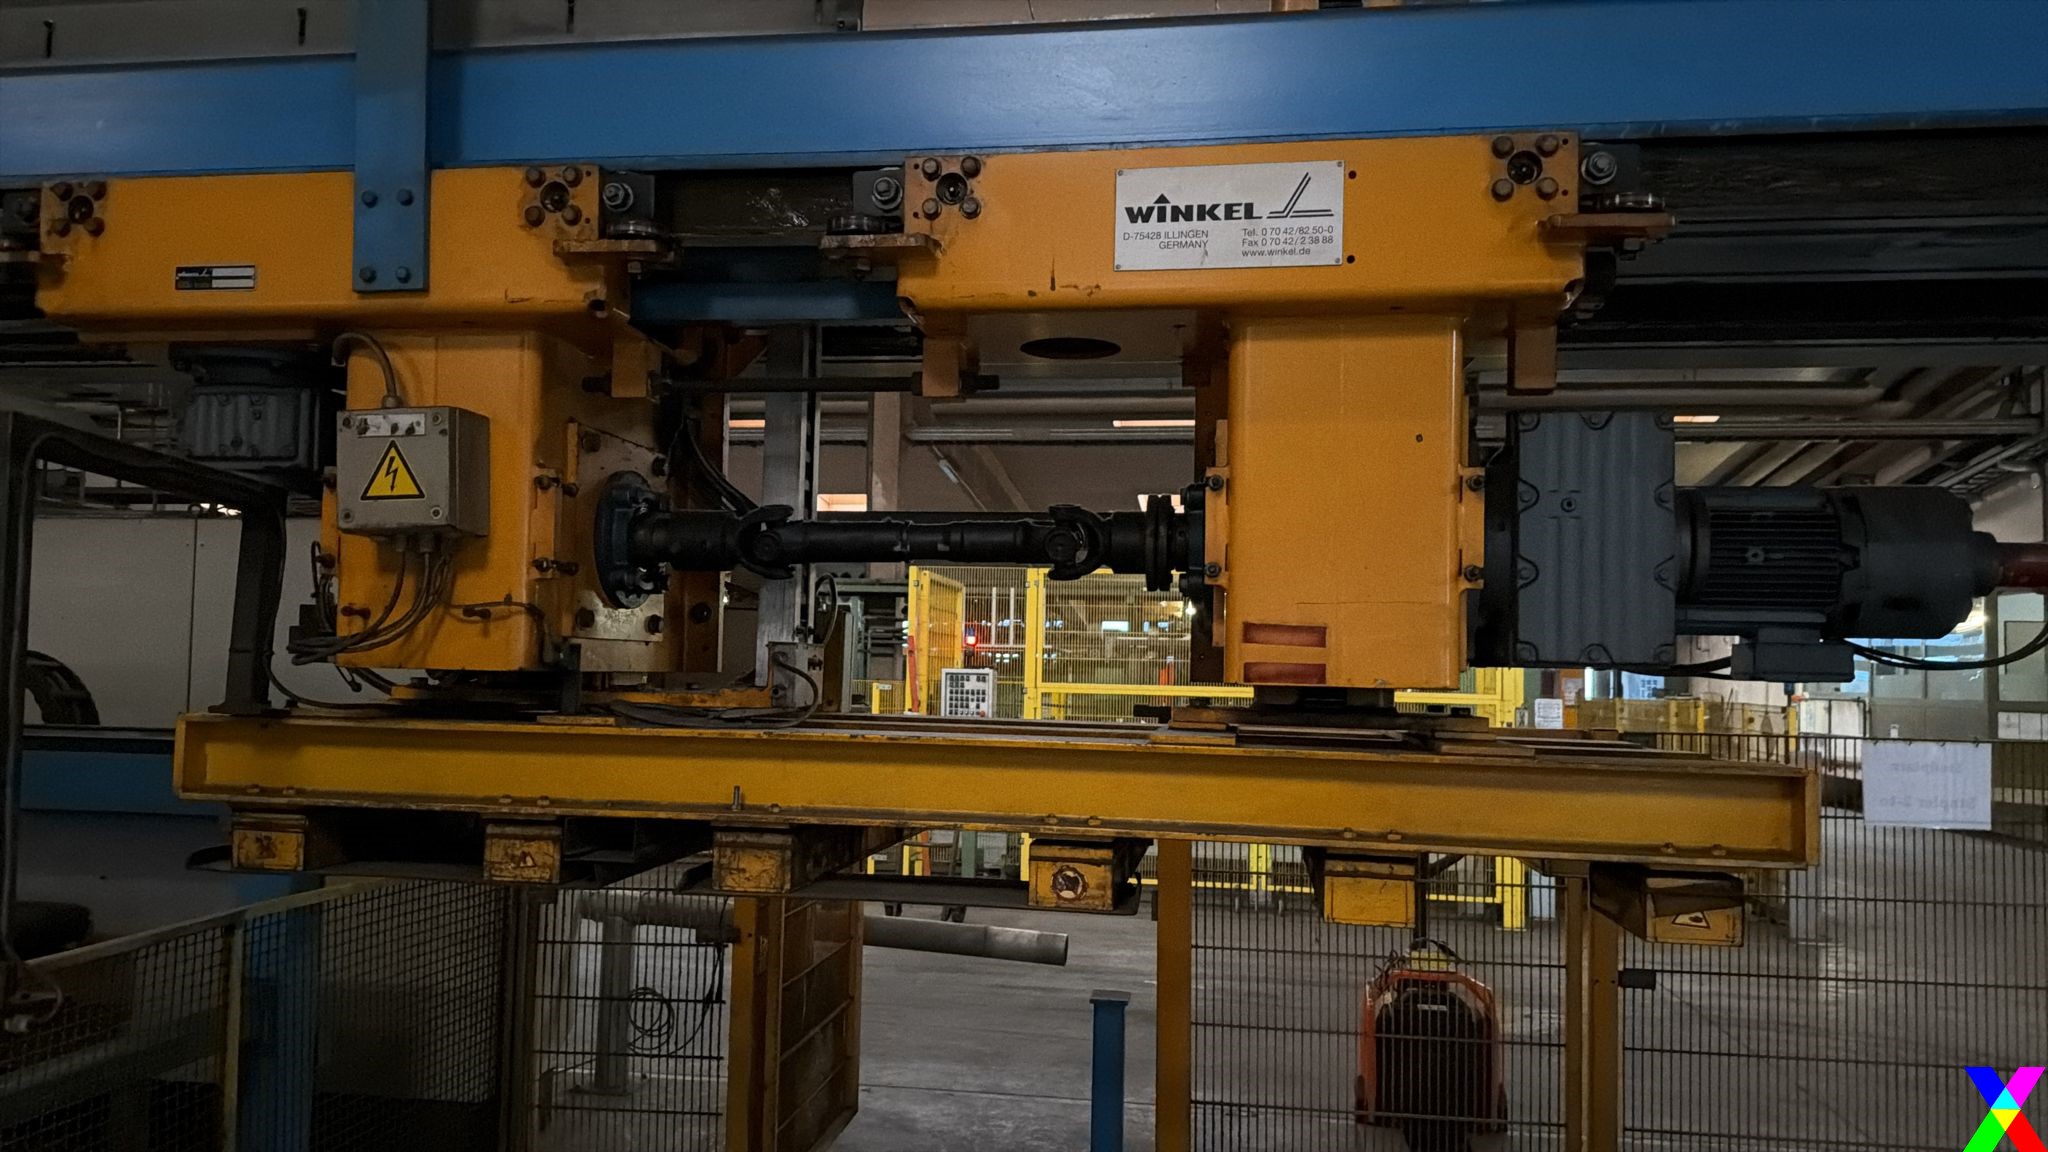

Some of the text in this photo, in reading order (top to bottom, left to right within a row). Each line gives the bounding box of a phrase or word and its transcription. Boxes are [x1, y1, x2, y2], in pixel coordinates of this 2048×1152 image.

[1124, 194, 1263, 223] WINKEL
[1123, 229, 1209, 241] D-75428 ILLINGEN
[1242, 228, 1259, 237] Tel.
[1311, 225, 1334, 235] 50-0
[1158, 240, 1209, 249] GERMANY
[1242, 238, 1259, 247] Fax
[1241, 247, 1311, 257] www.winkel.de
